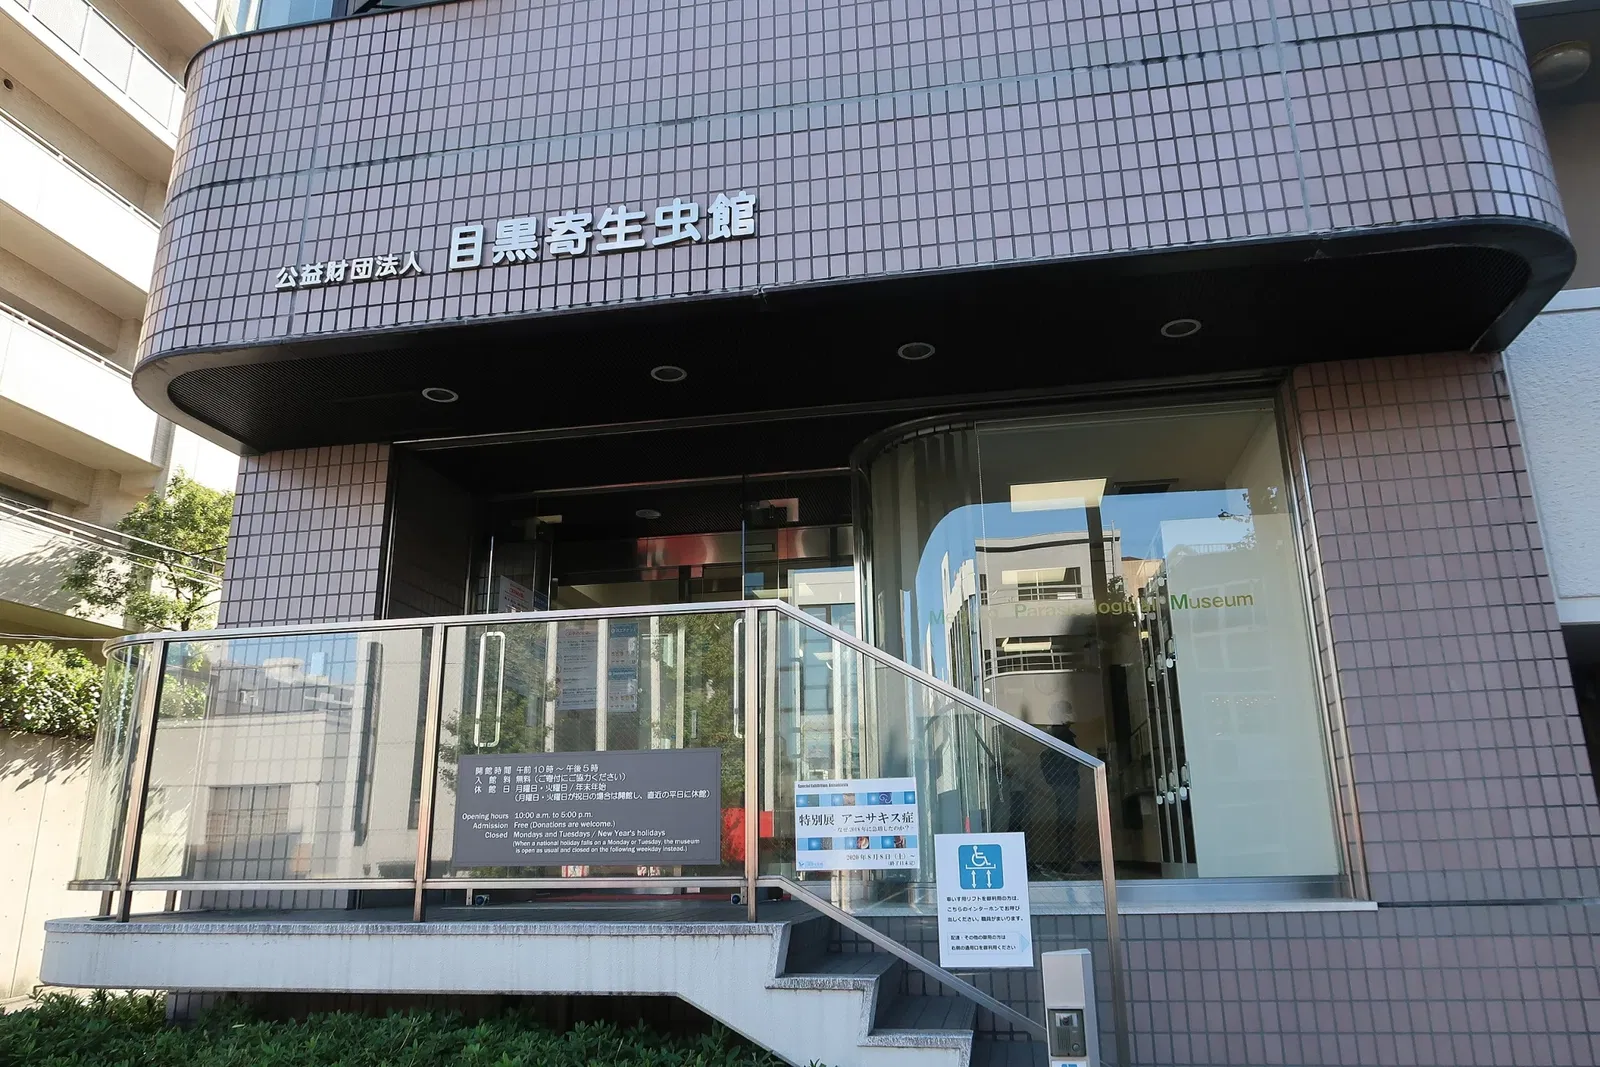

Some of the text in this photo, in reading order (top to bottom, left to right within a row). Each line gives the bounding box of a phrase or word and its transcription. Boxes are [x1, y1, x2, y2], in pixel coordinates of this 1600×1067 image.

[275, 190, 757, 289] 公益財団法人 目黒寄生虫館
[1170, 593, 1254, 610] Museum
[475, 766, 512, 775] 開館時間
[474, 785, 510, 794] 休館日
[462, 812, 490, 821] Opening
[578, 812, 594, 820] p.m.
[798, 812, 914, 826] 特別展 アニサキス症
[530, 821, 566, 829] (Donations
[580, 820, 616, 828] welcome.)
[513, 831, 542, 839] Mondays
[637, 829, 666, 837] holidays
